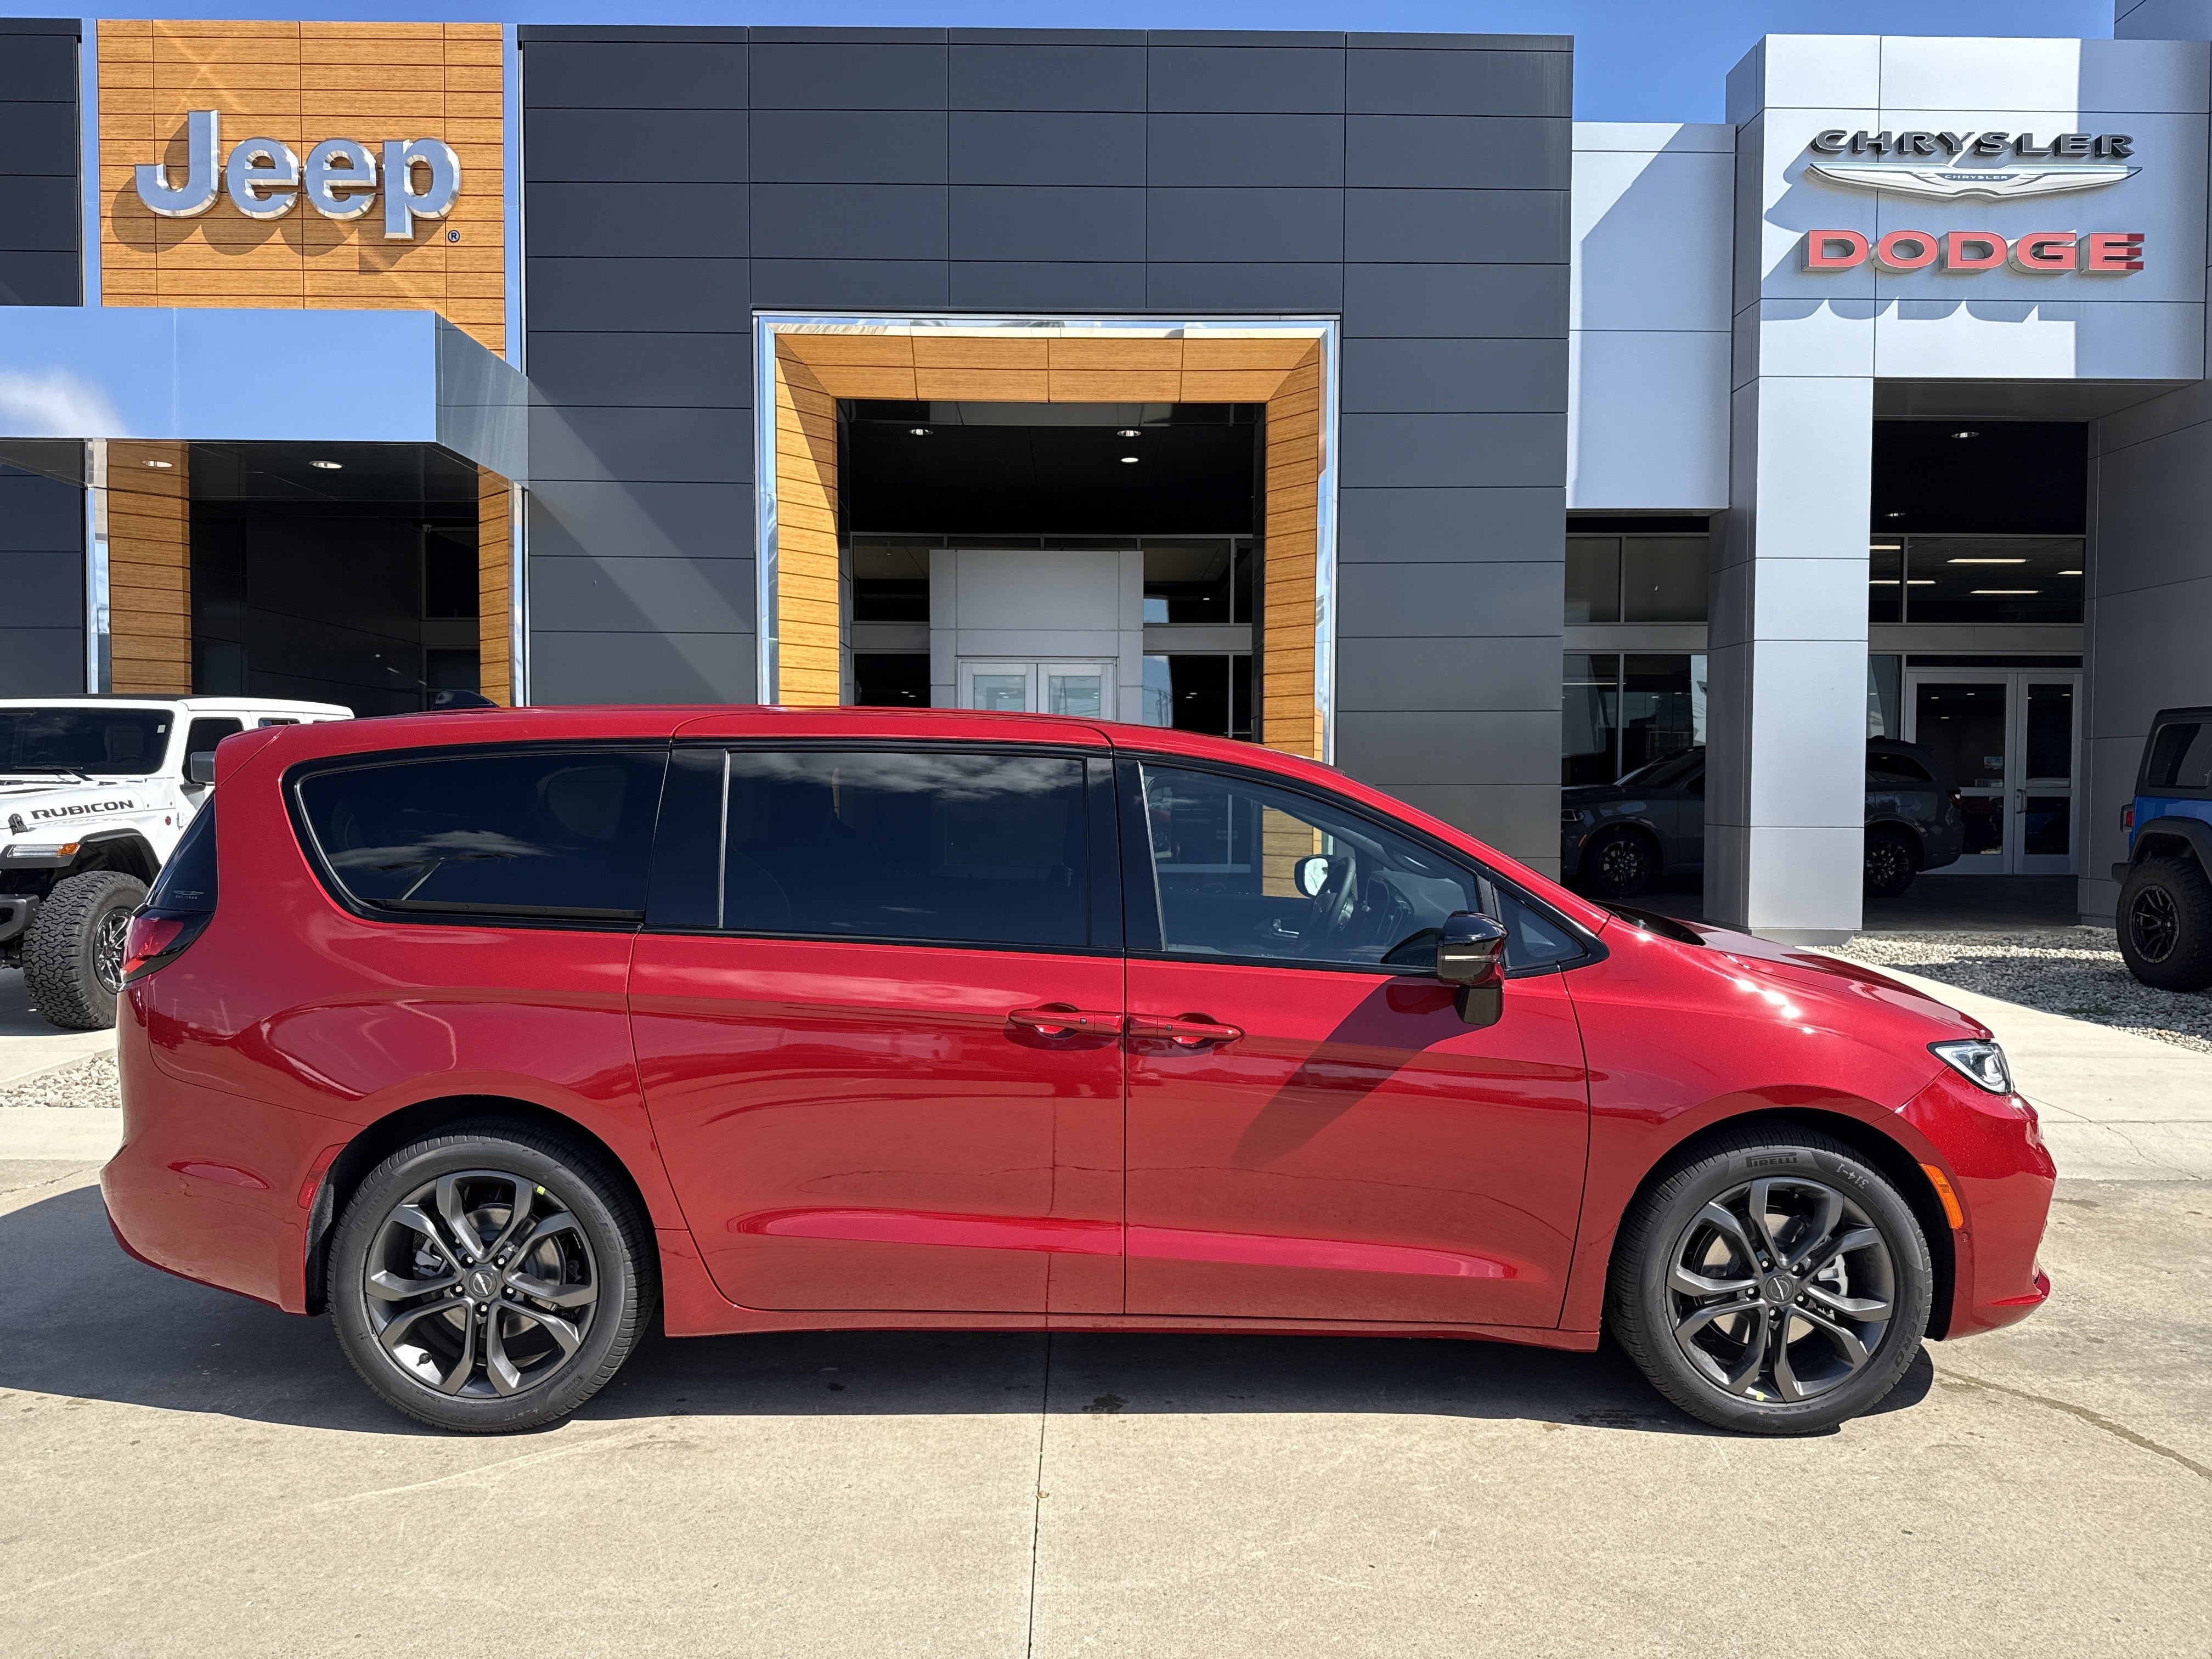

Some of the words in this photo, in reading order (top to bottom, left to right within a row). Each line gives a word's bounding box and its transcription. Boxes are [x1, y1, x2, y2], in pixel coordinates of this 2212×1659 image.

[1811, 129, 2135, 157] CHRYSLER
[134, 109, 462, 240] Jeep
[1802, 229, 2146, 274] DODGE
[30, 799, 134, 820] RUBICON
[1745, 1152, 1797, 1168] PIRELLI
[1894, 1305, 1921, 1367] ZERO
